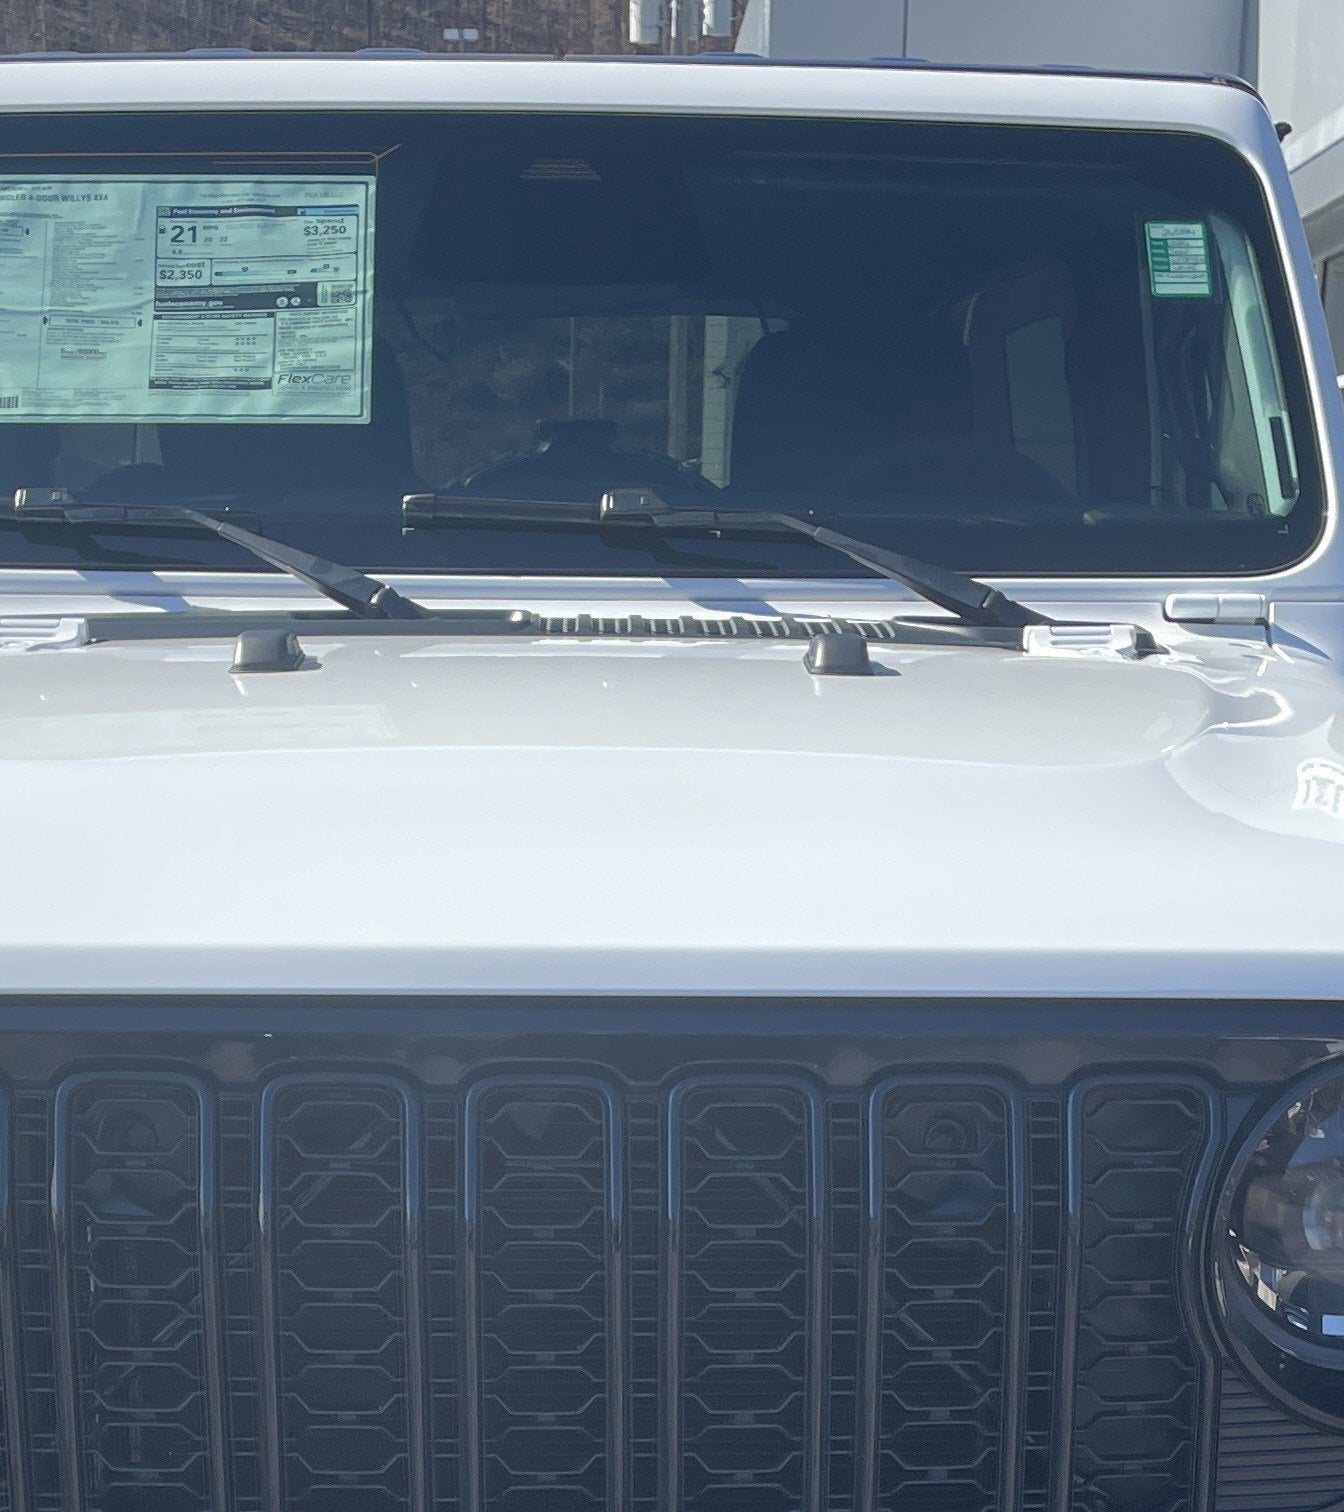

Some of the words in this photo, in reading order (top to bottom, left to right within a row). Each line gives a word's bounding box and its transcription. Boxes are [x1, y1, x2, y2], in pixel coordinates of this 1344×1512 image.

[170, 225, 197, 243] 21
[303, 225, 347, 236] $3,250
[159, 269, 203, 281] $2,350
[277, 372, 351, 385] FlexCare
